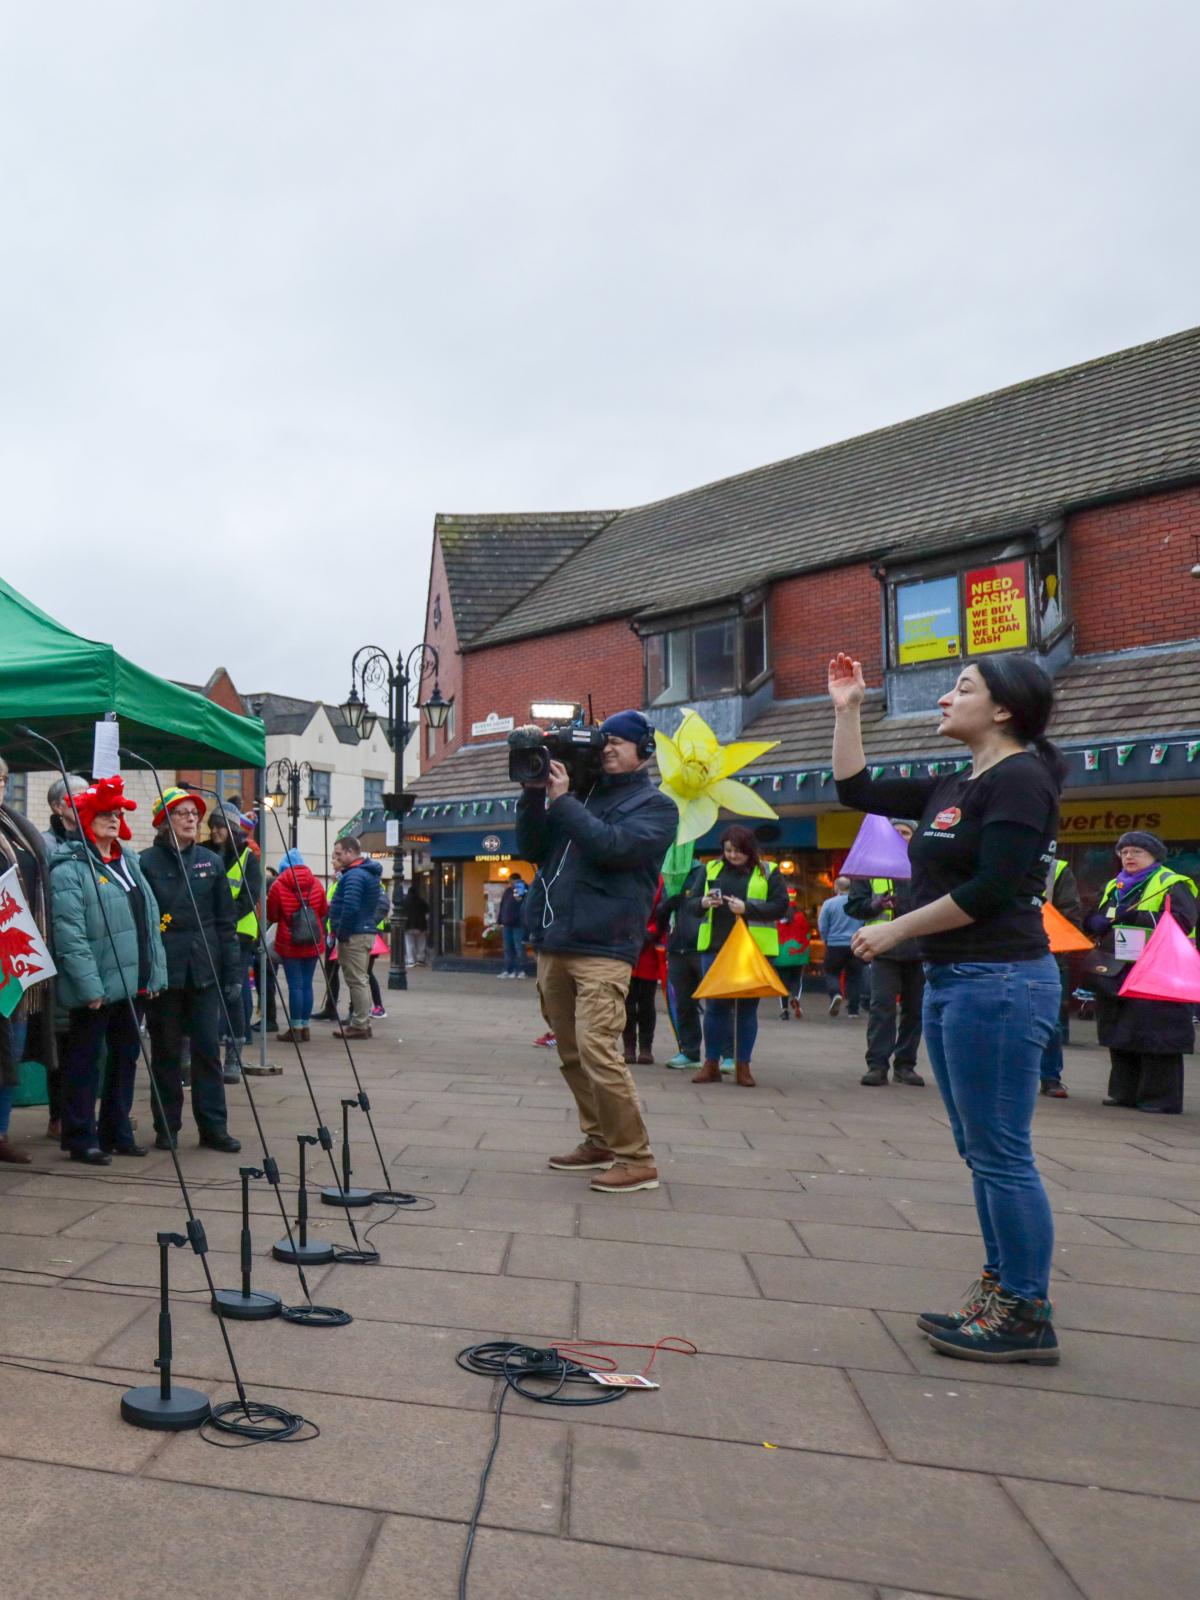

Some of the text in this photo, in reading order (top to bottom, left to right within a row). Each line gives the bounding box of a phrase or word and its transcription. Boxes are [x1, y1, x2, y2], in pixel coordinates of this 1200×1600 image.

[971, 577, 1013, 596] NEED
[972, 588, 1020, 607] CASH?
[972, 604, 1013, 618] WE BUY
[972, 614, 1018, 628] WE SELL
[973, 623, 1021, 637] WE LOAN
[973, 634, 1001, 645] CASH
[475, 854, 500, 862] ESPRESSO
